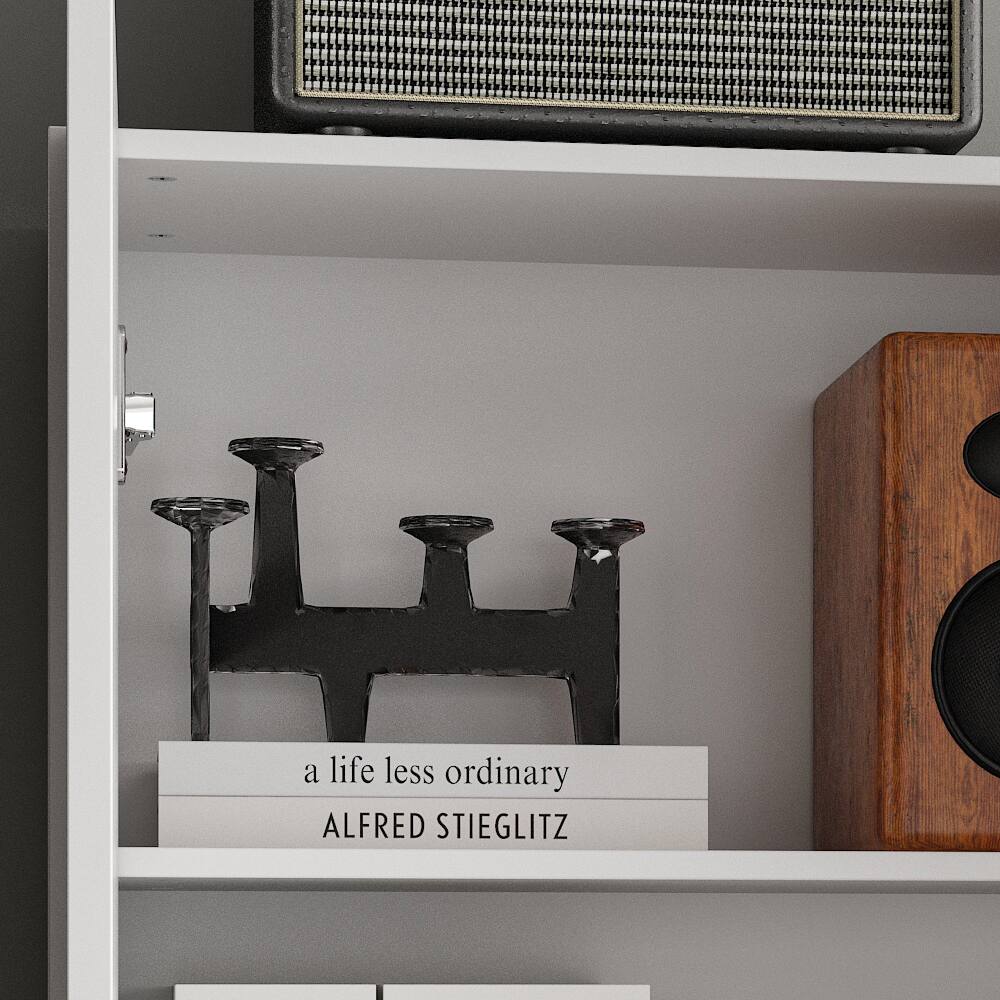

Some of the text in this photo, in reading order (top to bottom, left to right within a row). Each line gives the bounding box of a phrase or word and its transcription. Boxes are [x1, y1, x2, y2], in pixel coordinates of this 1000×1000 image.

[303, 756, 570, 792] a life less ordinary
[322, 812, 569, 841] ALFRED STIEGLITZ
